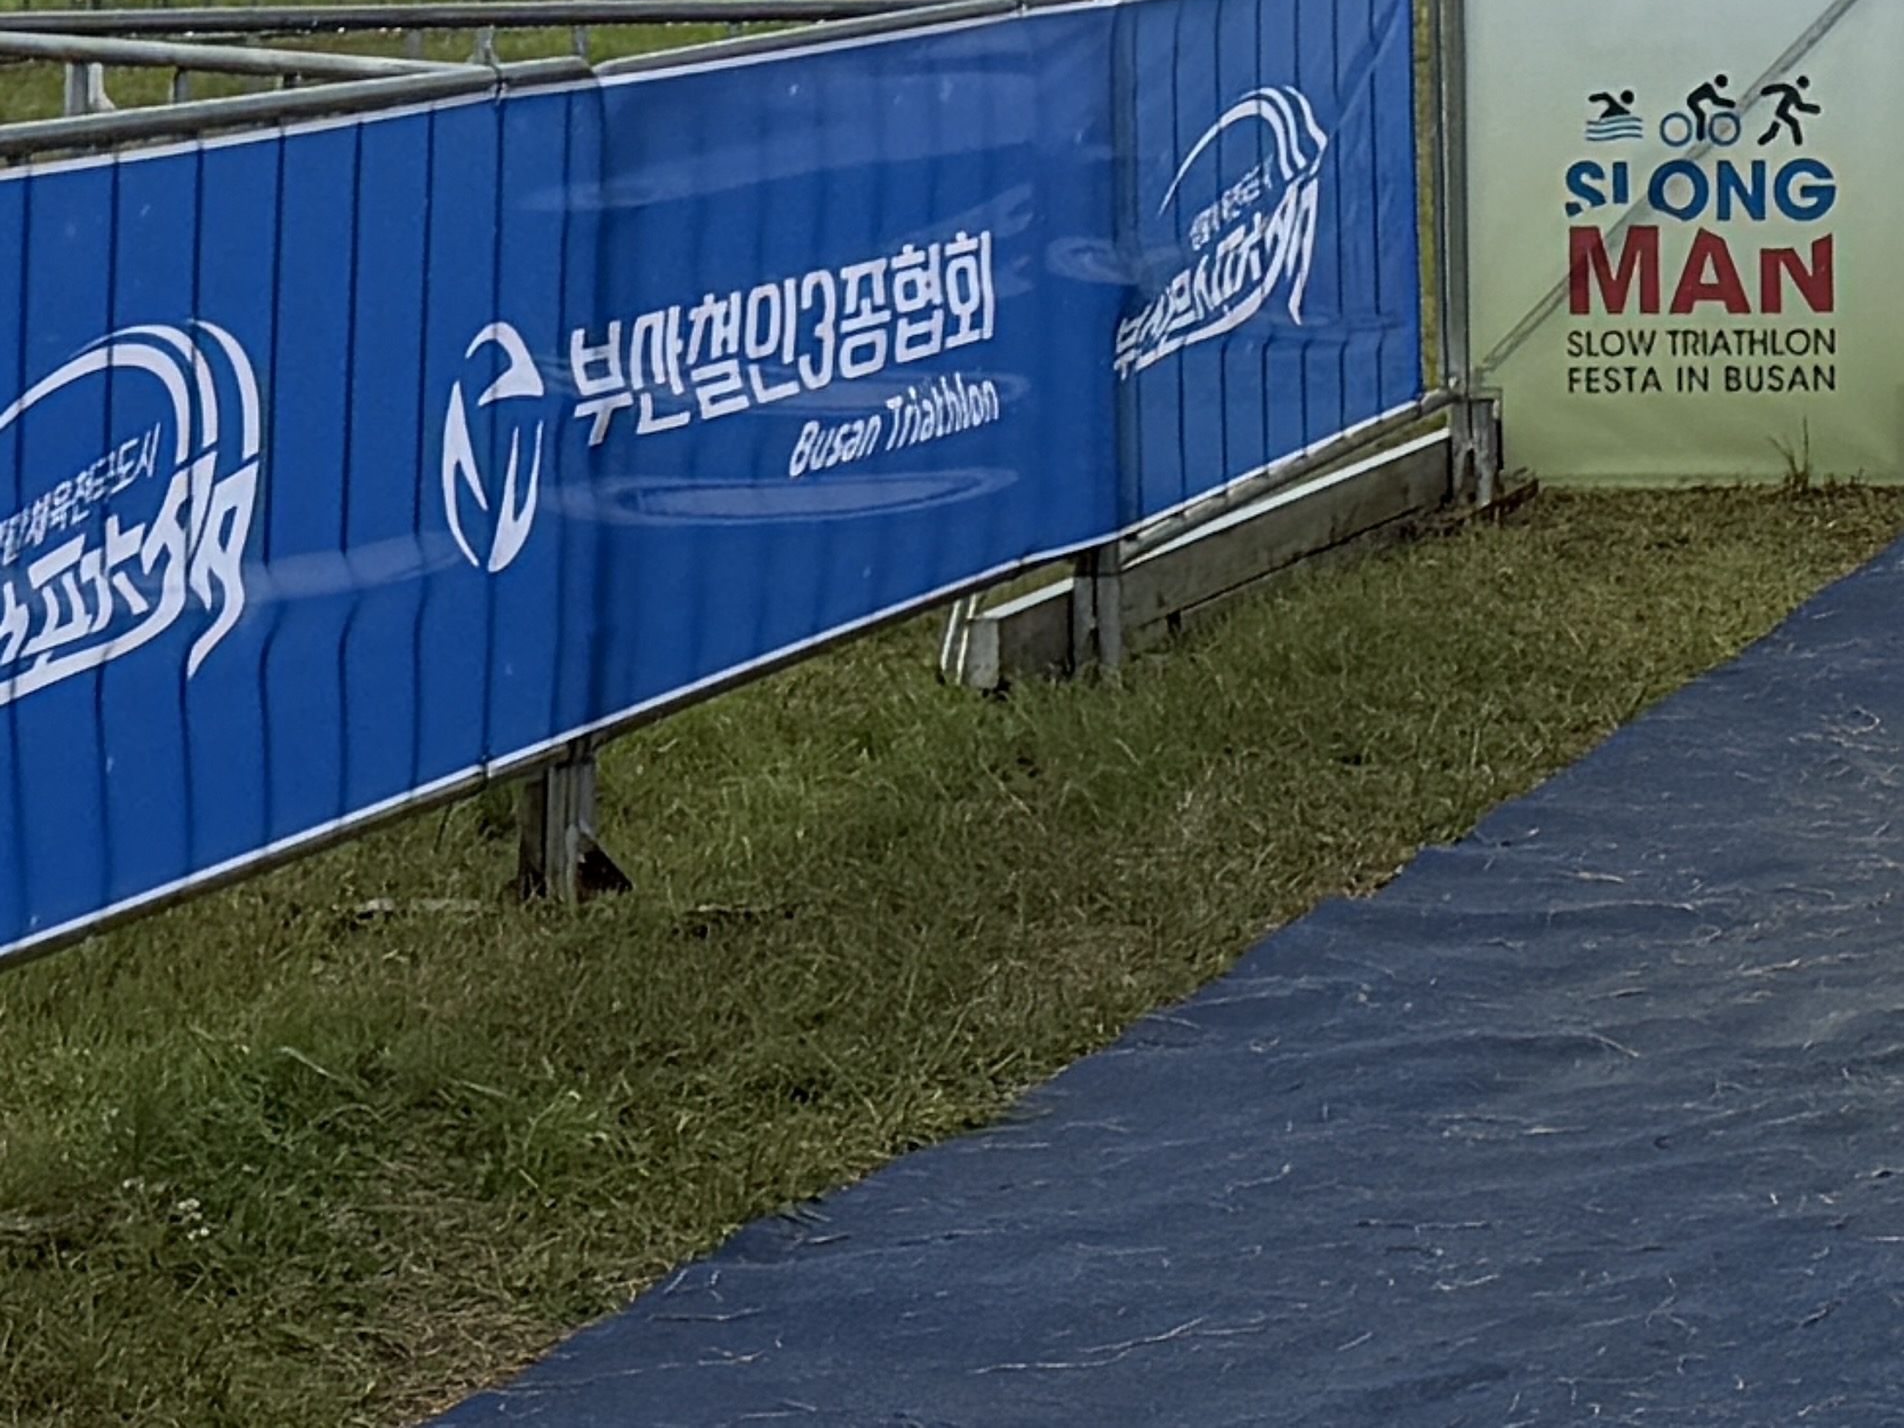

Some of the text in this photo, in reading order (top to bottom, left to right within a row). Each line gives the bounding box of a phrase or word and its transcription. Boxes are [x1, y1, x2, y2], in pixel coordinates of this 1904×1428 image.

[1568, 225, 1834, 315] MAN
[573, 231, 994, 447] 부산철인3종협회
[1567, 329, 1836, 358] SLOW TRIATHLON
[1568, 365, 1836, 394] FESTA IN BUSAN
[790, 372, 999, 478] Busan Triathlon
